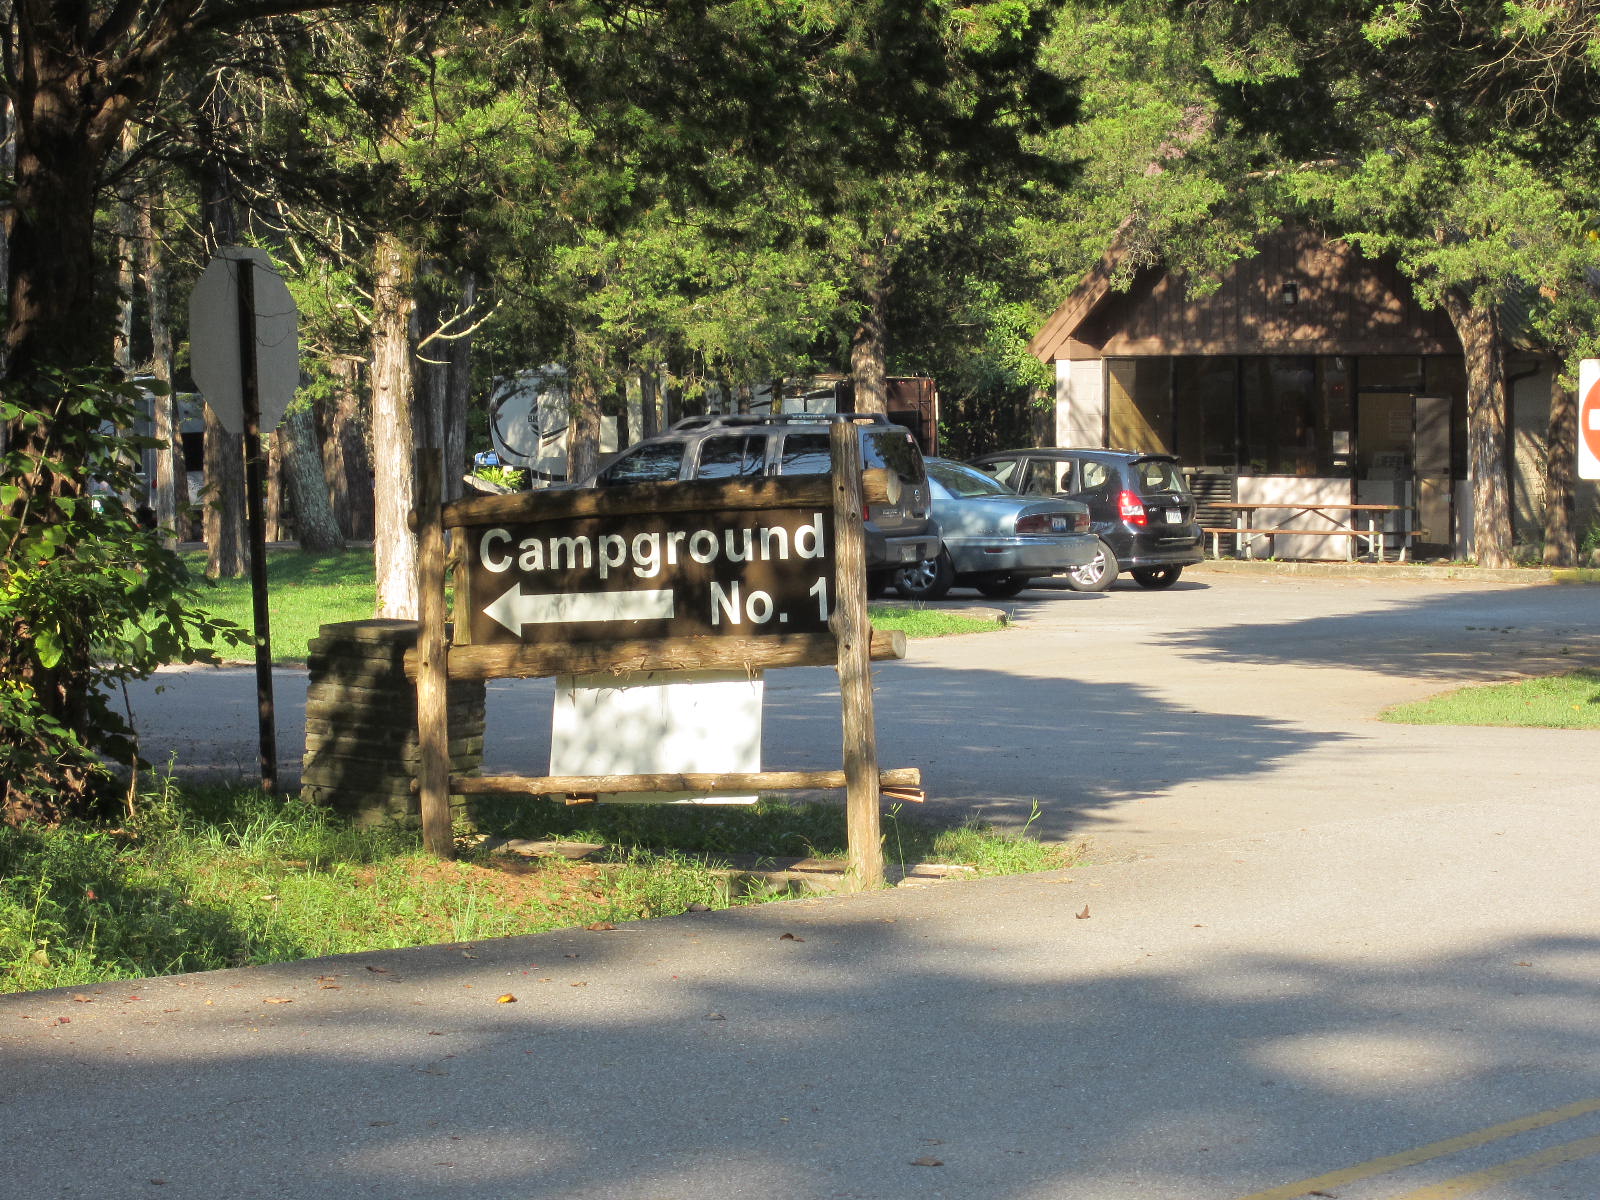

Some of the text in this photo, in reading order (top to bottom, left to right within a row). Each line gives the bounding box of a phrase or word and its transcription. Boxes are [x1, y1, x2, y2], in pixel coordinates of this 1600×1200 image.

[480, 513, 825, 580] Campground
[711, 576, 828, 625] No. 1
